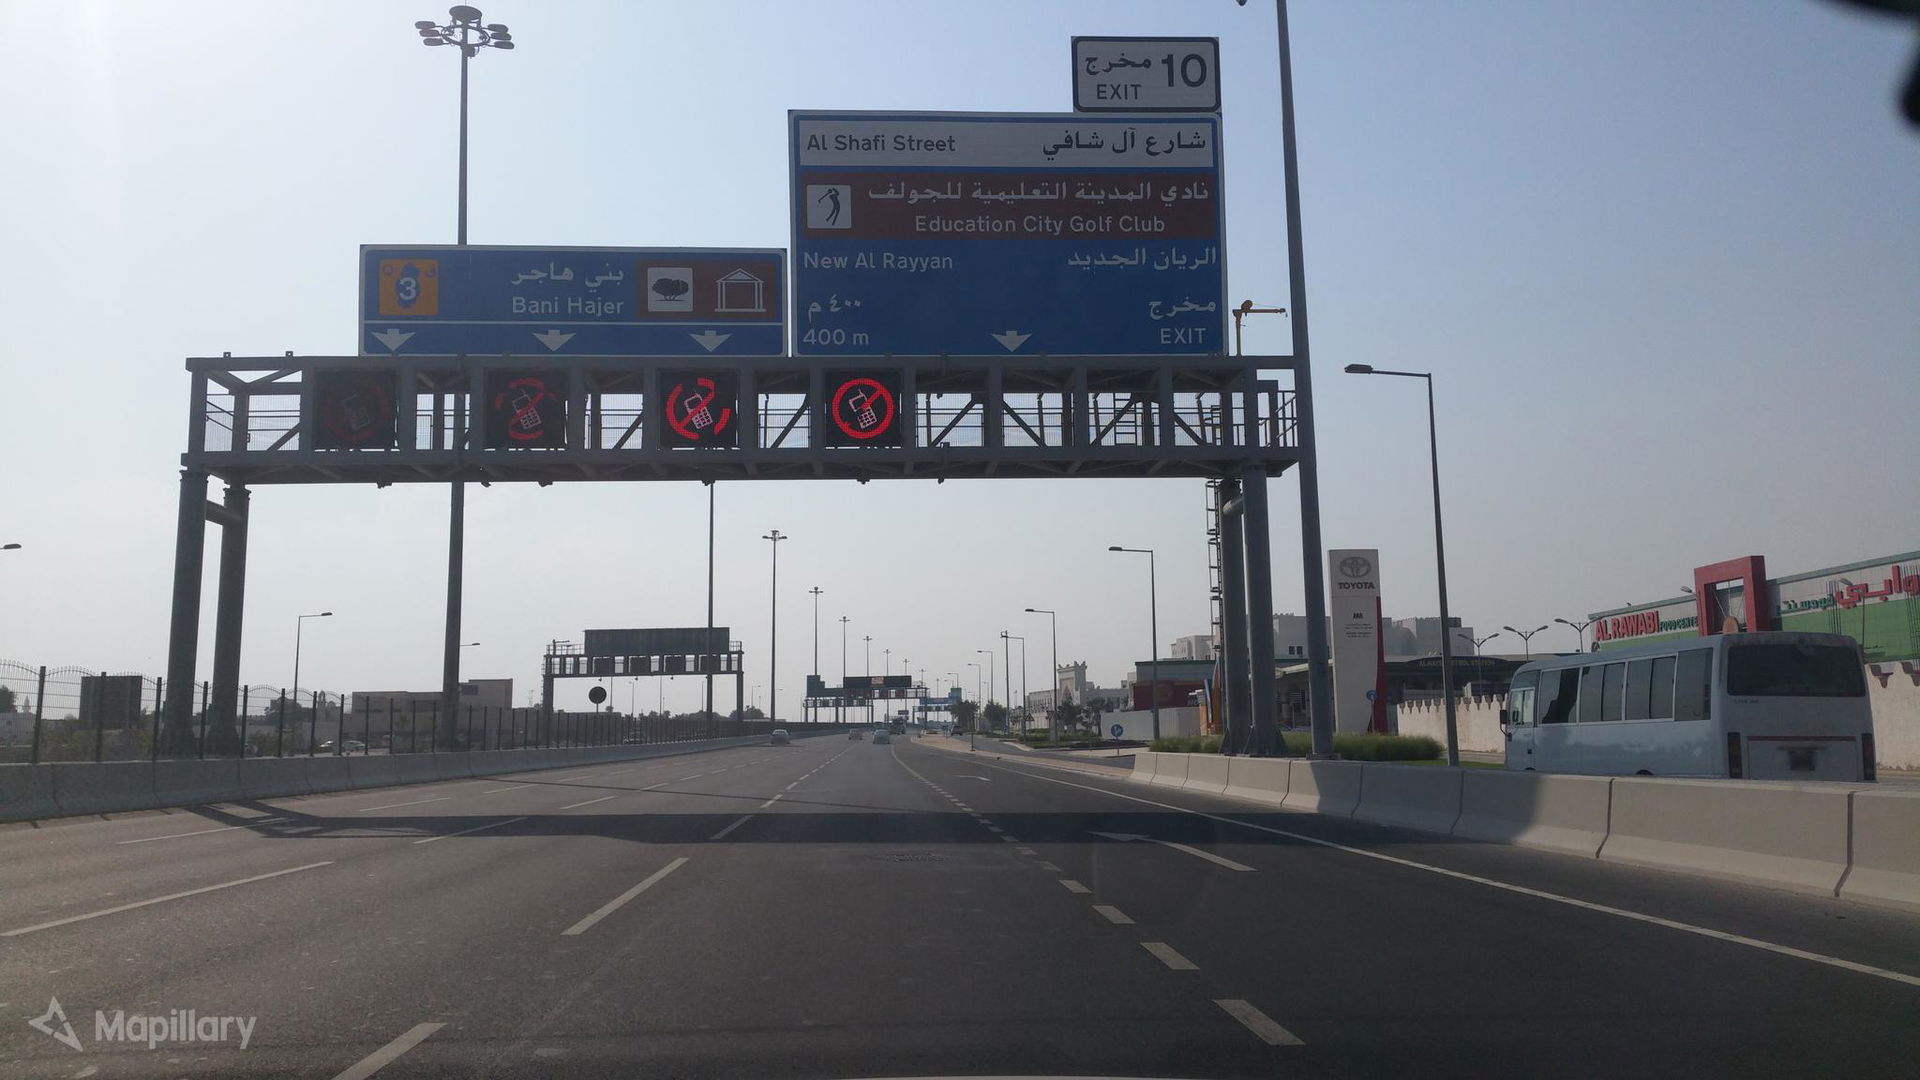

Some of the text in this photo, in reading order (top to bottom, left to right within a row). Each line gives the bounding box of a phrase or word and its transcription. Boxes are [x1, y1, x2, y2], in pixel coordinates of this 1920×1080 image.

[1085, 52, 1152, 76] مخرج
[1161, 53, 1207, 87] 10
[1096, 84, 1141, 100] EXIT
[807, 134, 956, 152] Al Shafi Street
[1042, 127, 1206, 161] شارع آل شافي
[868, 181, 1209, 207] نادي المدينة التعليمية للجولف
[915, 215, 1165, 236] Education City Golf Club
[803, 252, 953, 273] New Al Rayyan
[1067, 246, 1216, 271] الريان الجديد
[399, 276, 417, 300] 3
[511, 261, 624, 293] بني هاجر
[512, 296, 624, 317] Bani Hajer
[1149, 296, 1216, 320] مخرج
[803, 328, 869, 346] 400 m
[1160, 328, 1206, 345] EXIT
[1338, 582, 1375, 590] TOYOTA
[1595, 620, 1613, 642] AL
[1611, 610, 1660, 639] RAWABI
